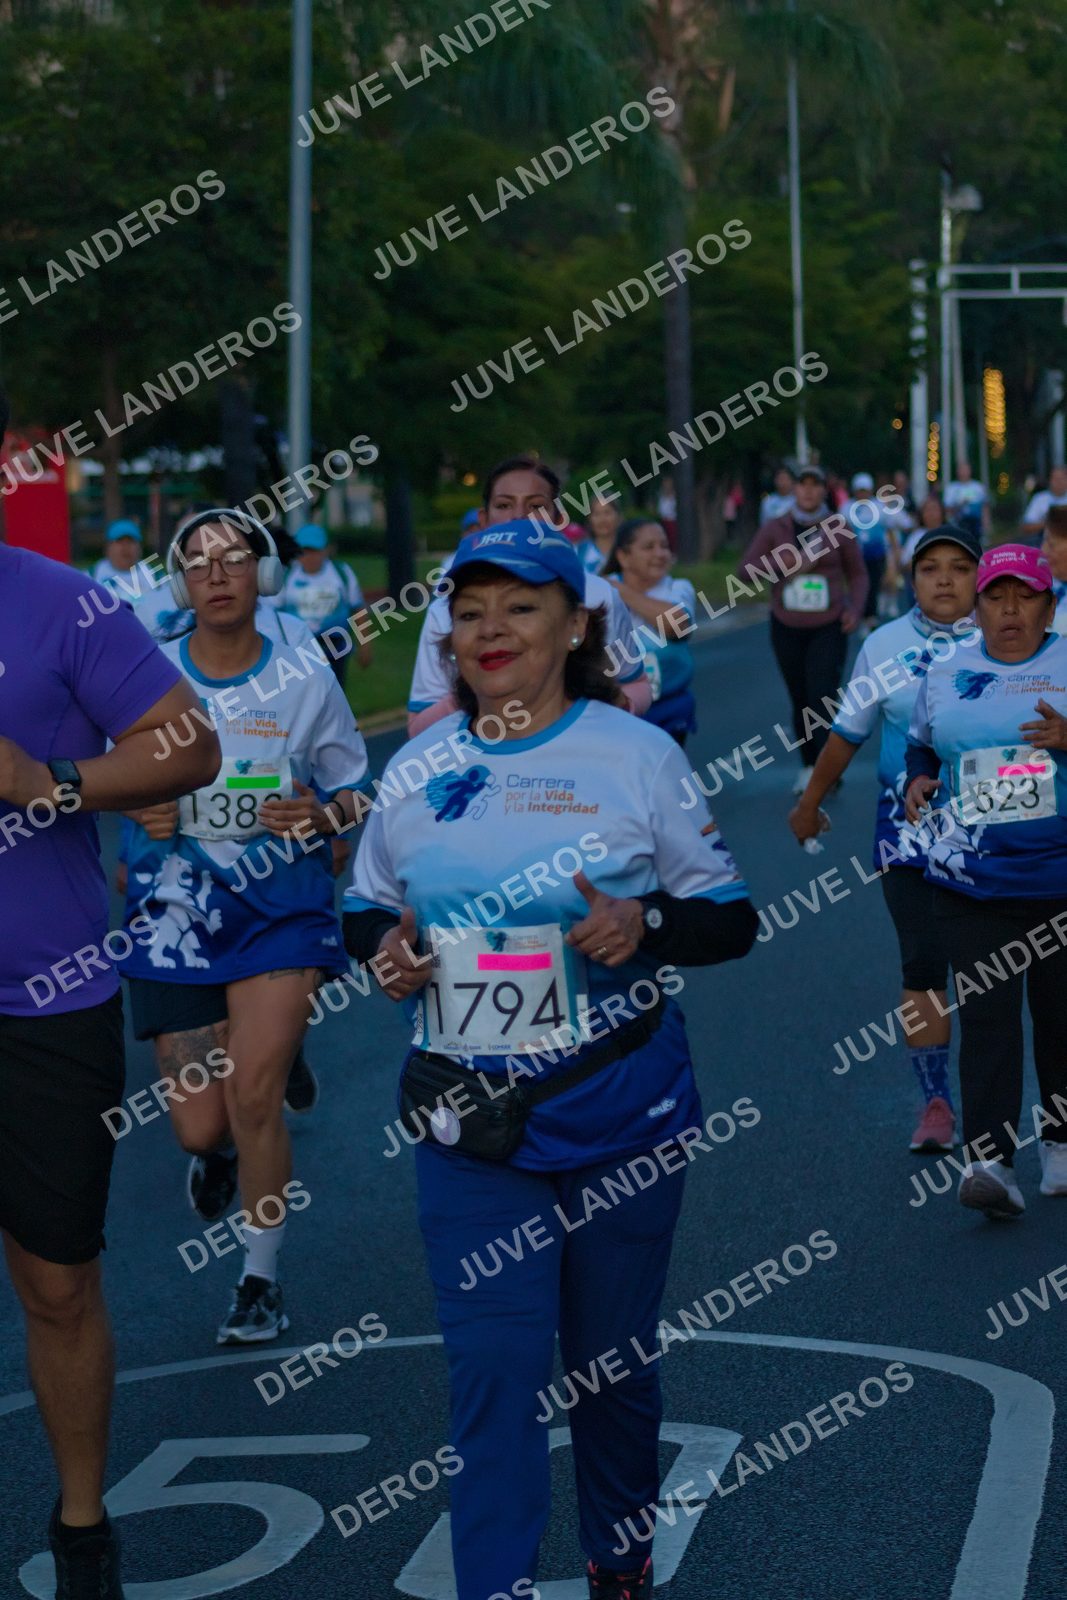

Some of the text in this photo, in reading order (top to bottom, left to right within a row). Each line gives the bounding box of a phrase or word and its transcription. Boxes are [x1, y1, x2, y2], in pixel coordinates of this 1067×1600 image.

[226, 706, 277, 719] Carrera
[255, 718, 278, 728] Vida
[243, 727, 290, 738] Integrida
[506, 774, 575, 790] Carrera
[505, 789, 574, 803] por la Vida
[976, 778, 1040, 813] 523
[187, 792, 282, 830] 138
[504, 802, 599, 816] y la Integridad
[430, 976, 566, 1036] 1794
